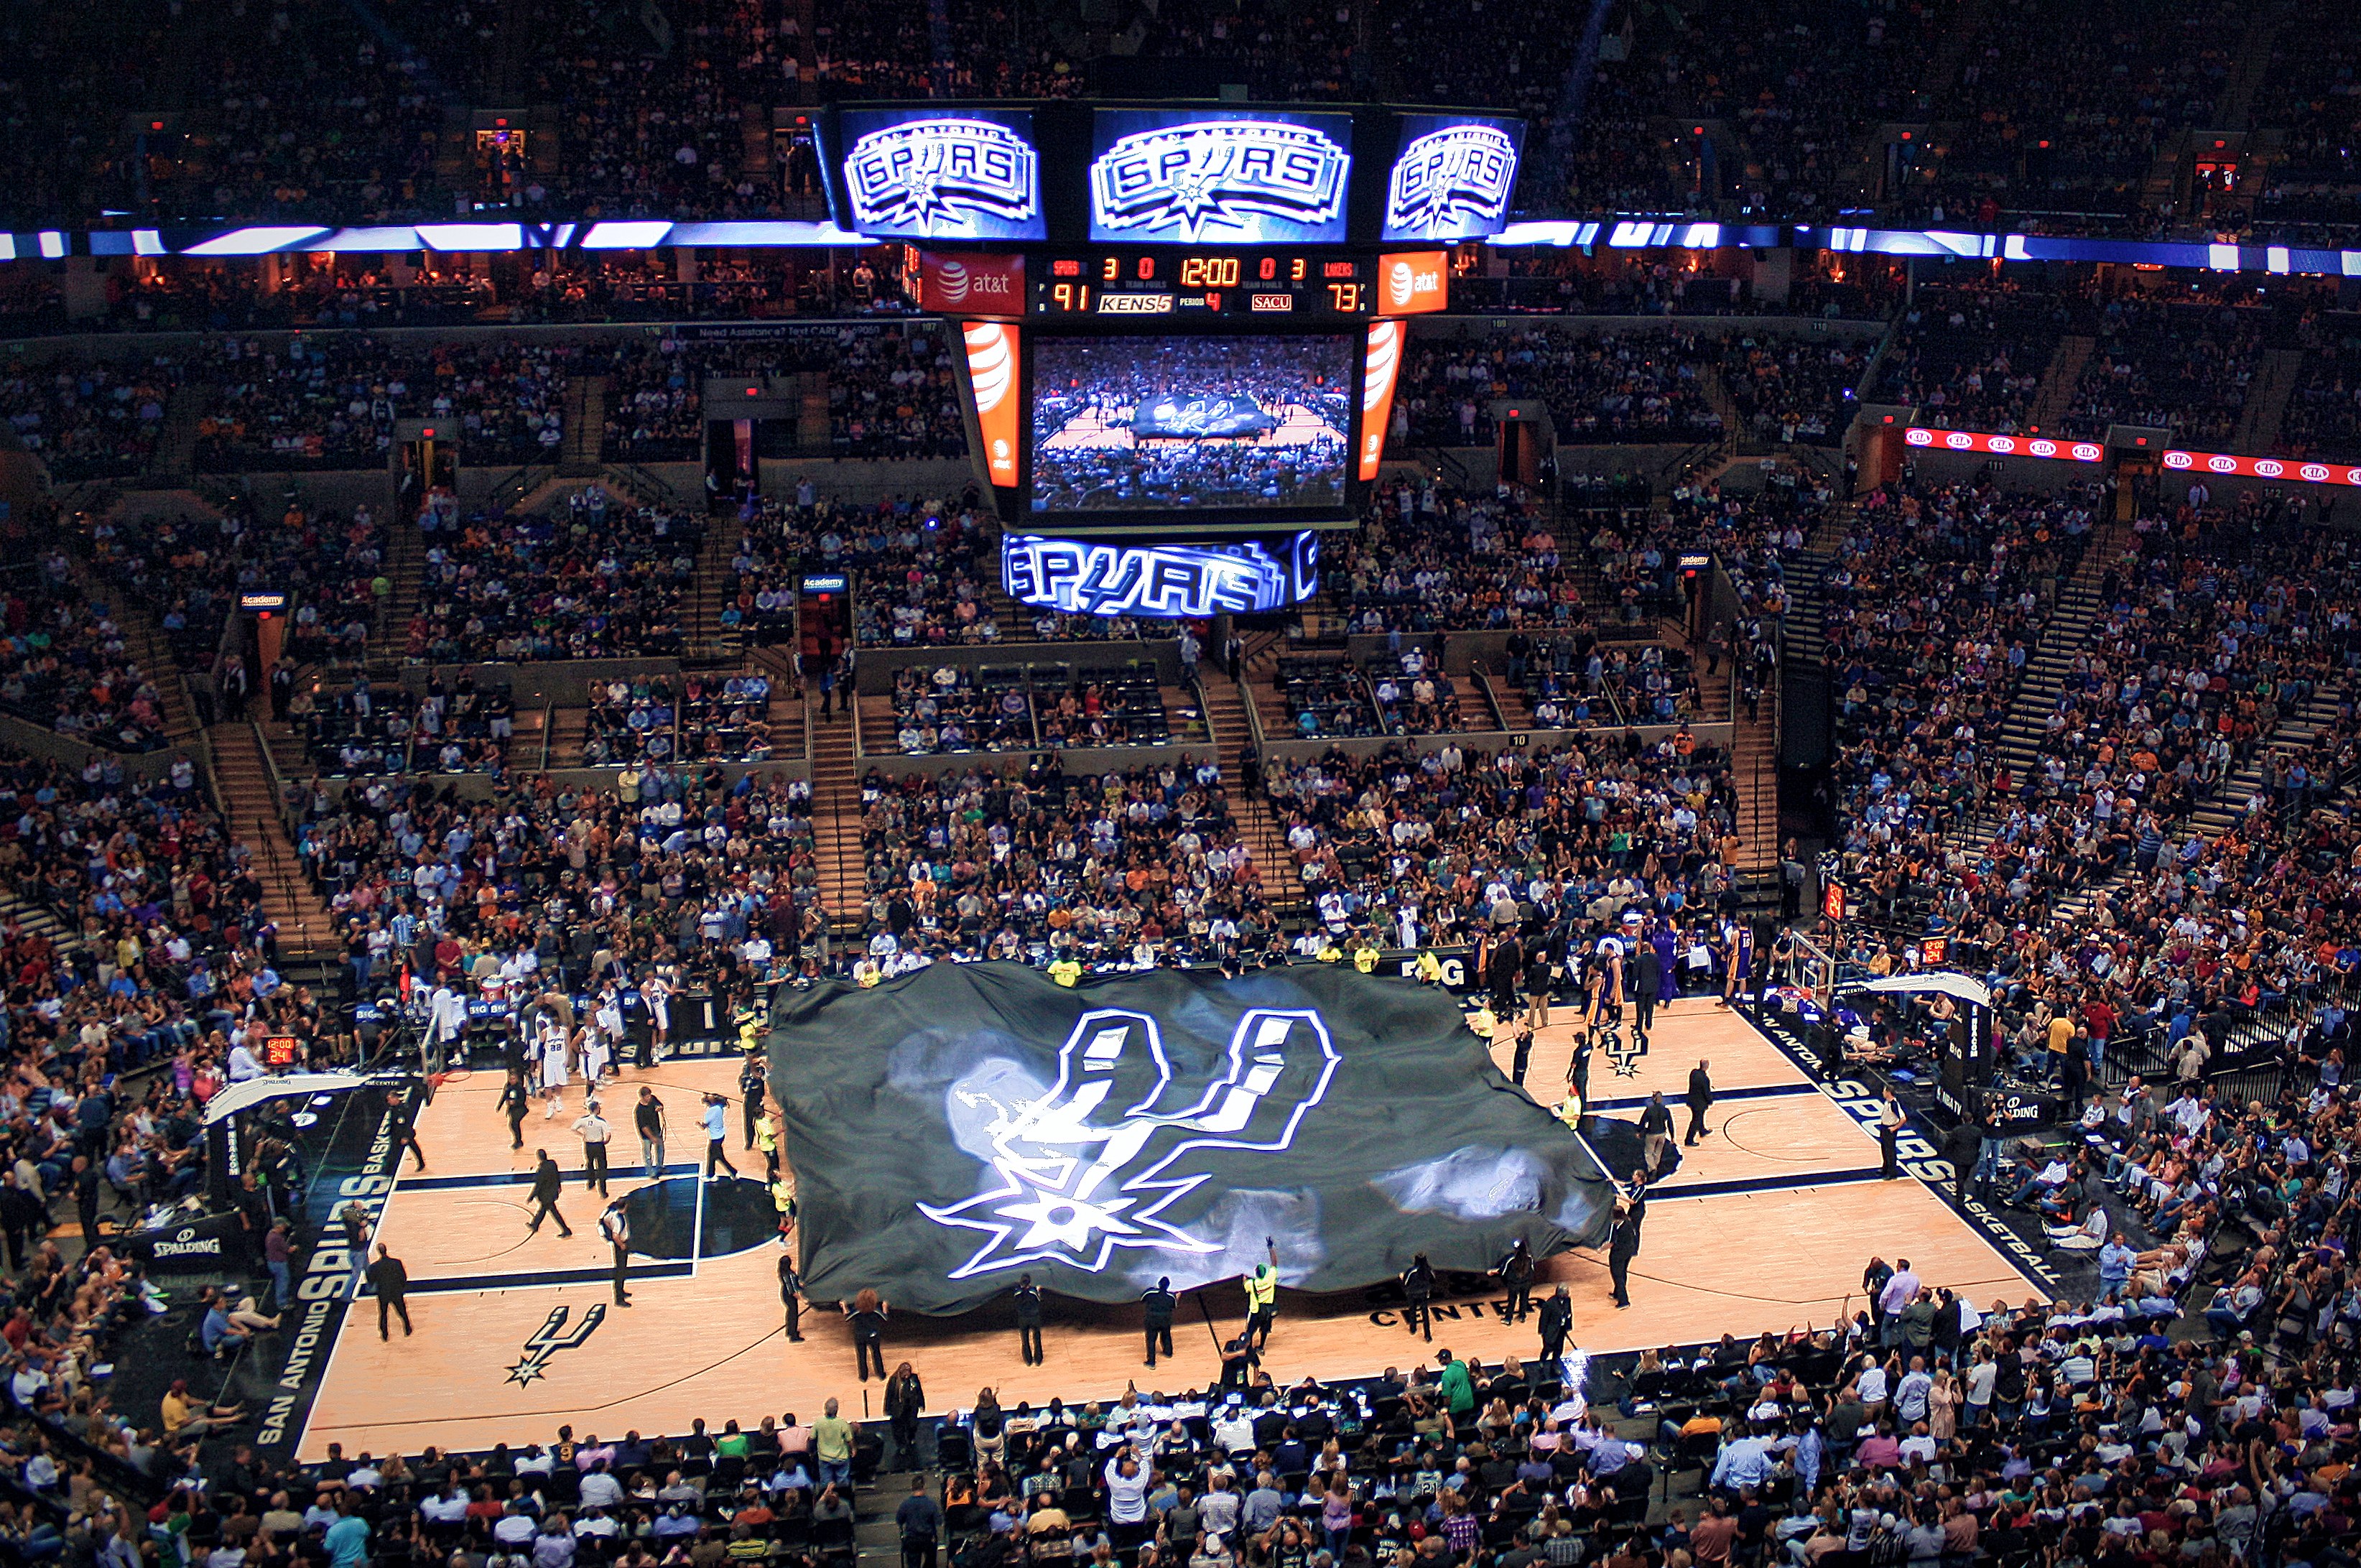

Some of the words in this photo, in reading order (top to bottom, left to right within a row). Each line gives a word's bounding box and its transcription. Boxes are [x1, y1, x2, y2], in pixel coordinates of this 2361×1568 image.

[860, 140, 1014, 194] SPURS
[1115, 142, 1325, 198] SPURS
[1403, 147, 1503, 198] SPURS
[1053, 260, 1080, 276] SPURS
[1103, 257, 1118, 279] 3
[1138, 256, 1155, 279] 0
[1180, 256, 1240, 286] 12:00
[1260, 257, 1275, 279] 0
[1291, 258, 1307, 280] 3
[973, 273, 1009, 293] at&t
[1414, 271, 1438, 291] at&t
[1052, 284, 1089, 311] 91
[1205, 292, 1220, 311] 4
[1254, 297, 1290, 309] SACU
[1327, 284, 1359, 312] 73
[700, 328, 727, 338] Need
[730, 327, 785, 336] Assistance?
[789, 327, 808, 335] Text
[810, 326, 837, 335] CARE
[1952, 437, 1969, 445] KIA
[1993, 440, 2010, 449] KIA
[2035, 444, 2052, 453] KIA
[2077, 448, 2095, 457] KIA
[2169, 455, 2188, 465] KIA
[2213, 460, 2232, 469] KIA
[2259, 464, 2278, 473] KIA
[2305, 468, 2324, 478] KIA
[803, 577, 843, 588] Academy
[1008, 542, 1257, 616] SPURS
[241, 595, 284, 605] Academy
[1513, 735, 1526, 746] 10
[1829, 895, 1841, 918] 24
[1925, 941, 1945, 950] 12:00
[1927, 951, 1940, 962] 24
[268, 1041, 292, 1049] 12:00
[270, 1051, 286, 1062] 24
[1773, 1029, 1837, 1080] ANTON
[1954, 1100, 1963, 1116] TV
[2009, 1104, 2039, 1118] LDING
[1819, 1080, 1958, 1182] SPURS
[296, 1174, 394, 1300] SPURS
[153, 1238, 221, 1257] SPALDING
[279, 1300, 331, 1390] ANTONIO
[256, 1393, 297, 1445] SAN
[560, 1446, 572, 1462] 9
